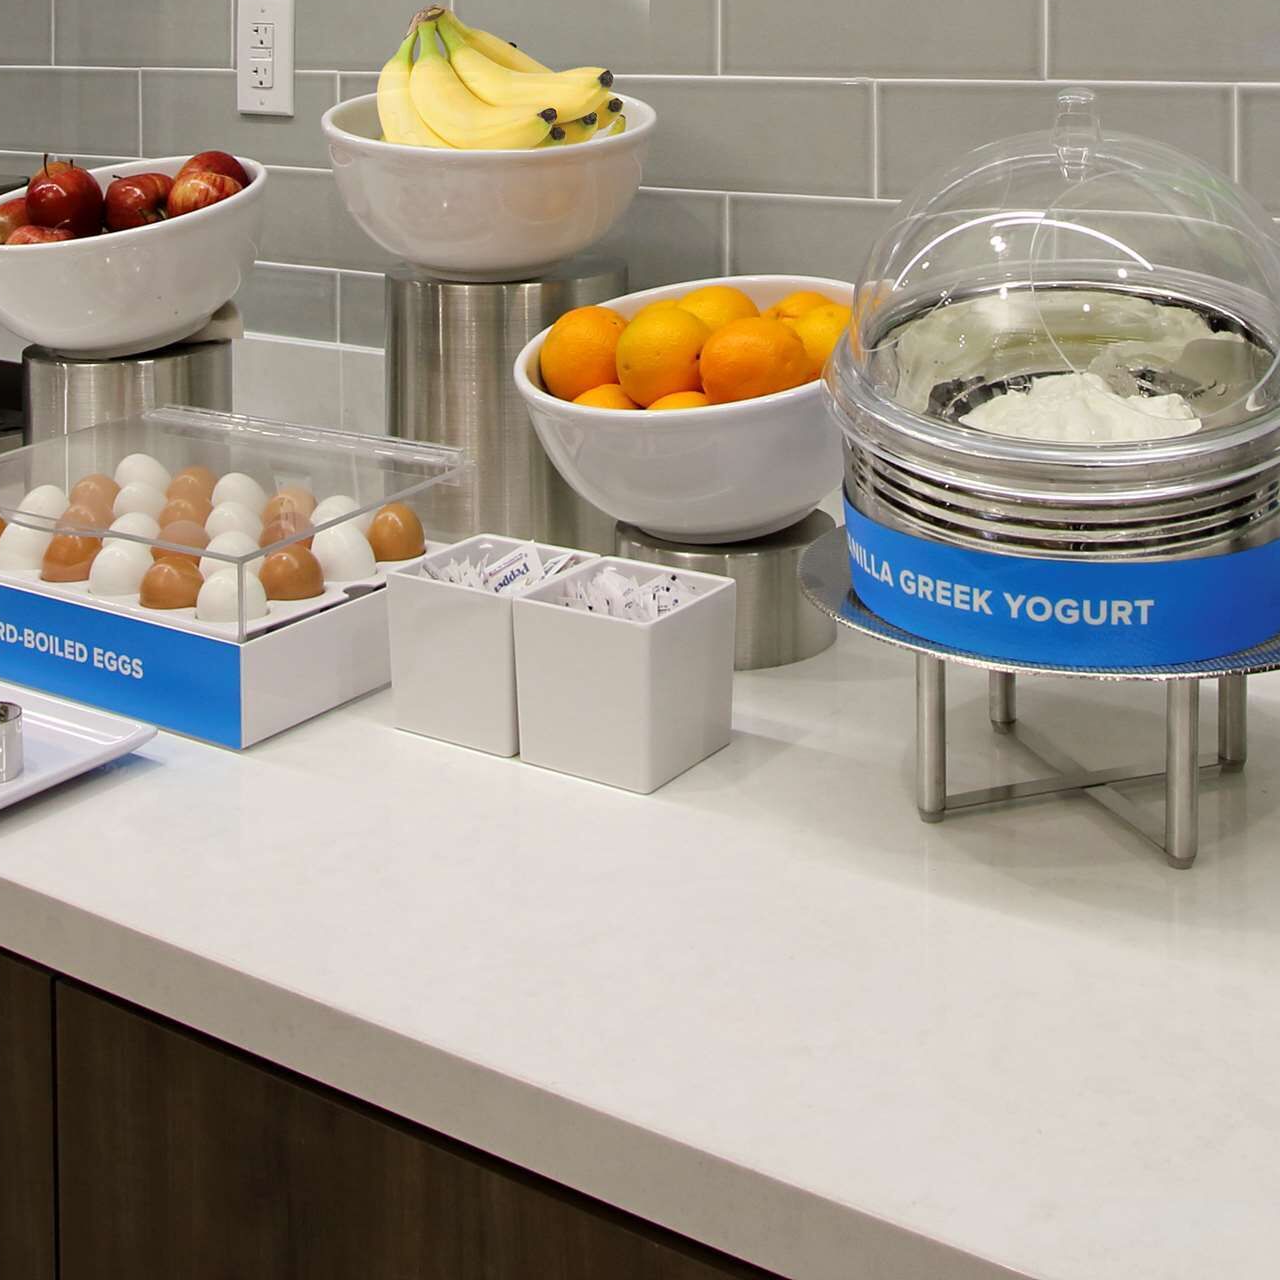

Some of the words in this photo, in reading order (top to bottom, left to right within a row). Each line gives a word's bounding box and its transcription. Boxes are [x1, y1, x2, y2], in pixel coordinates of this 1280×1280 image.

[847, 528, 894, 587] NILLA
[900, 569, 993, 615] GREEK
[1003, 591, 1154, 625] YOGURT
[93, 647, 144, 680] EGGS
